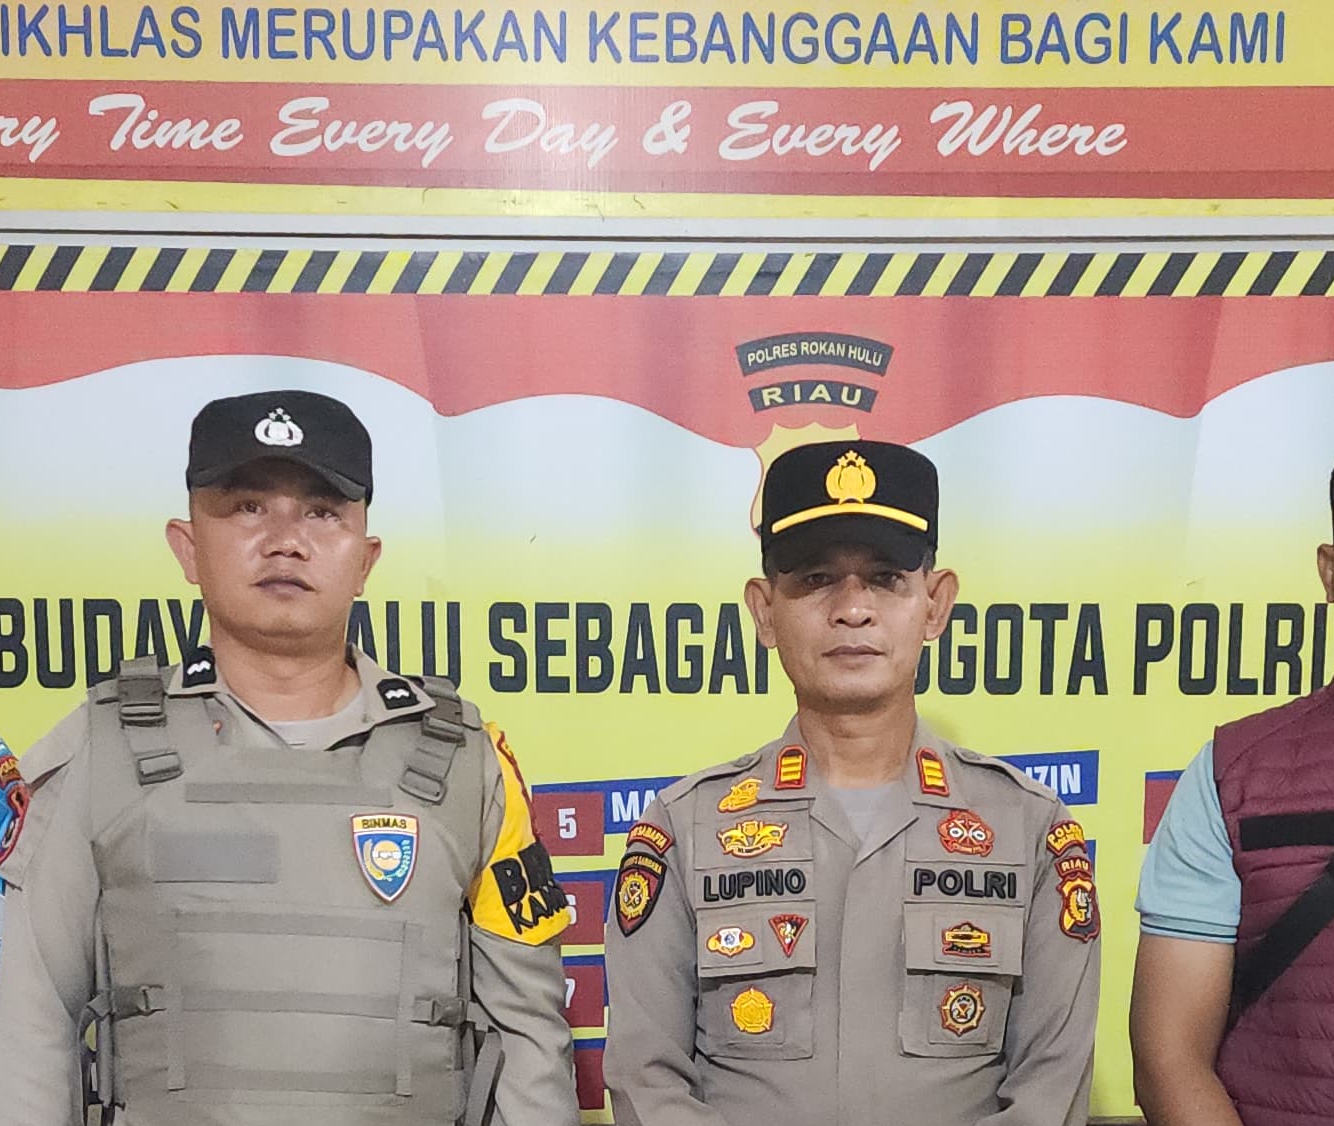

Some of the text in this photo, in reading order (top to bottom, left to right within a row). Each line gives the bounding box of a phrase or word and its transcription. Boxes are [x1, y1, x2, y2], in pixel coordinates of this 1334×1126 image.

[1, 4, 202, 60] IKHLAS
[222, 7, 567, 64] MERUPAKAN
[589, 11, 980, 66] KEBANGGAAN
[1000, 12, 1128, 66] BAGI
[1150, 11, 1285, 66] KAMI
[89, 94, 243, 153] Time
[270, 96, 453, 169] Every
[482, 98, 618, 162] Day
[643, 102, 690, 156] &
[718, 101, 902, 170] Every
[930, 101, 1128, 158] Where
[747, 341, 883, 367] POLRES ROKAN HULU
[761, 383, 862, 407] RIAU
[347, 601, 462, 690] ALU
[1133, 603, 1328, 696] POLRI
[361, 817, 408, 830] BINMAS
[558, 807, 577, 840] 5
[1061, 858, 1089, 871] RIAU
[703, 868, 806, 902] LUPINO
[913, 868, 1017, 899] POLRI
